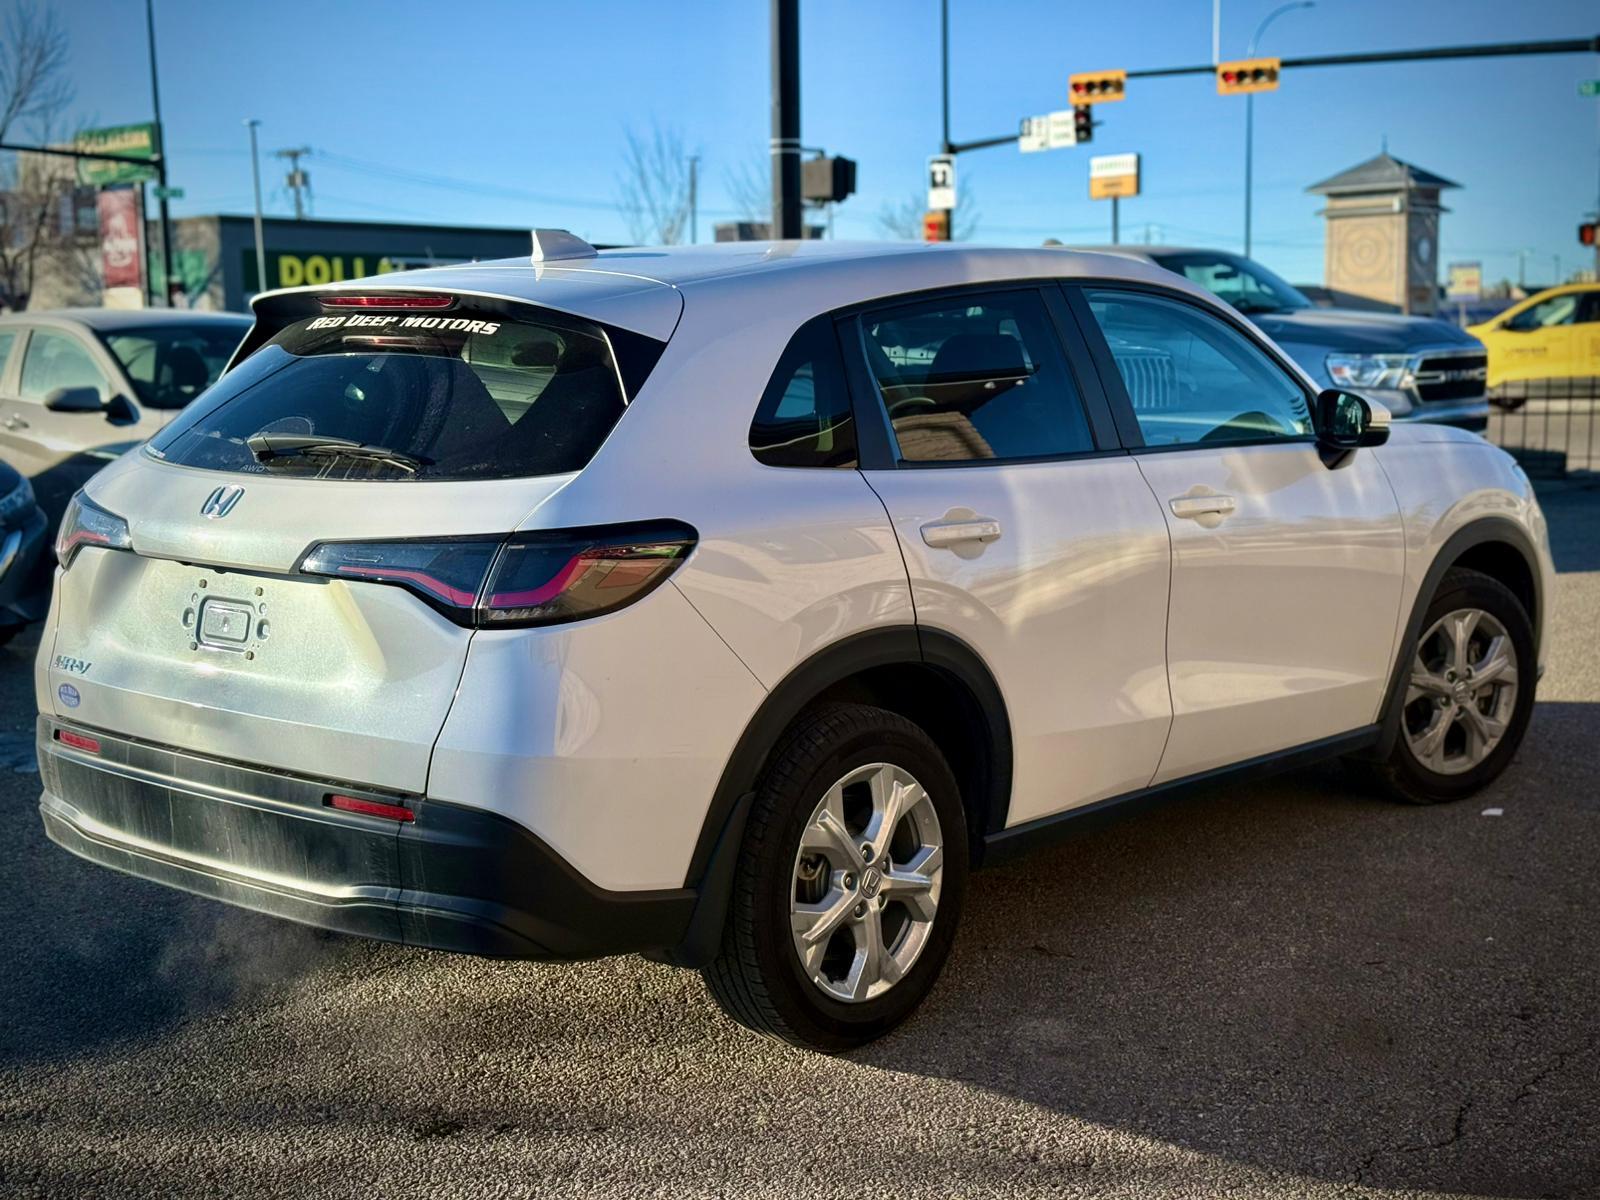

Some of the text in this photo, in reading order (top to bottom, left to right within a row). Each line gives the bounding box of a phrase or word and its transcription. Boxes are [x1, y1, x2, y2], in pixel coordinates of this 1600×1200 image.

[278, 254, 404, 287] DOLLA
[305, 316, 346, 331] RED
[398, 317, 501, 335] MOTORS
[240, 464, 265, 473] AWD
